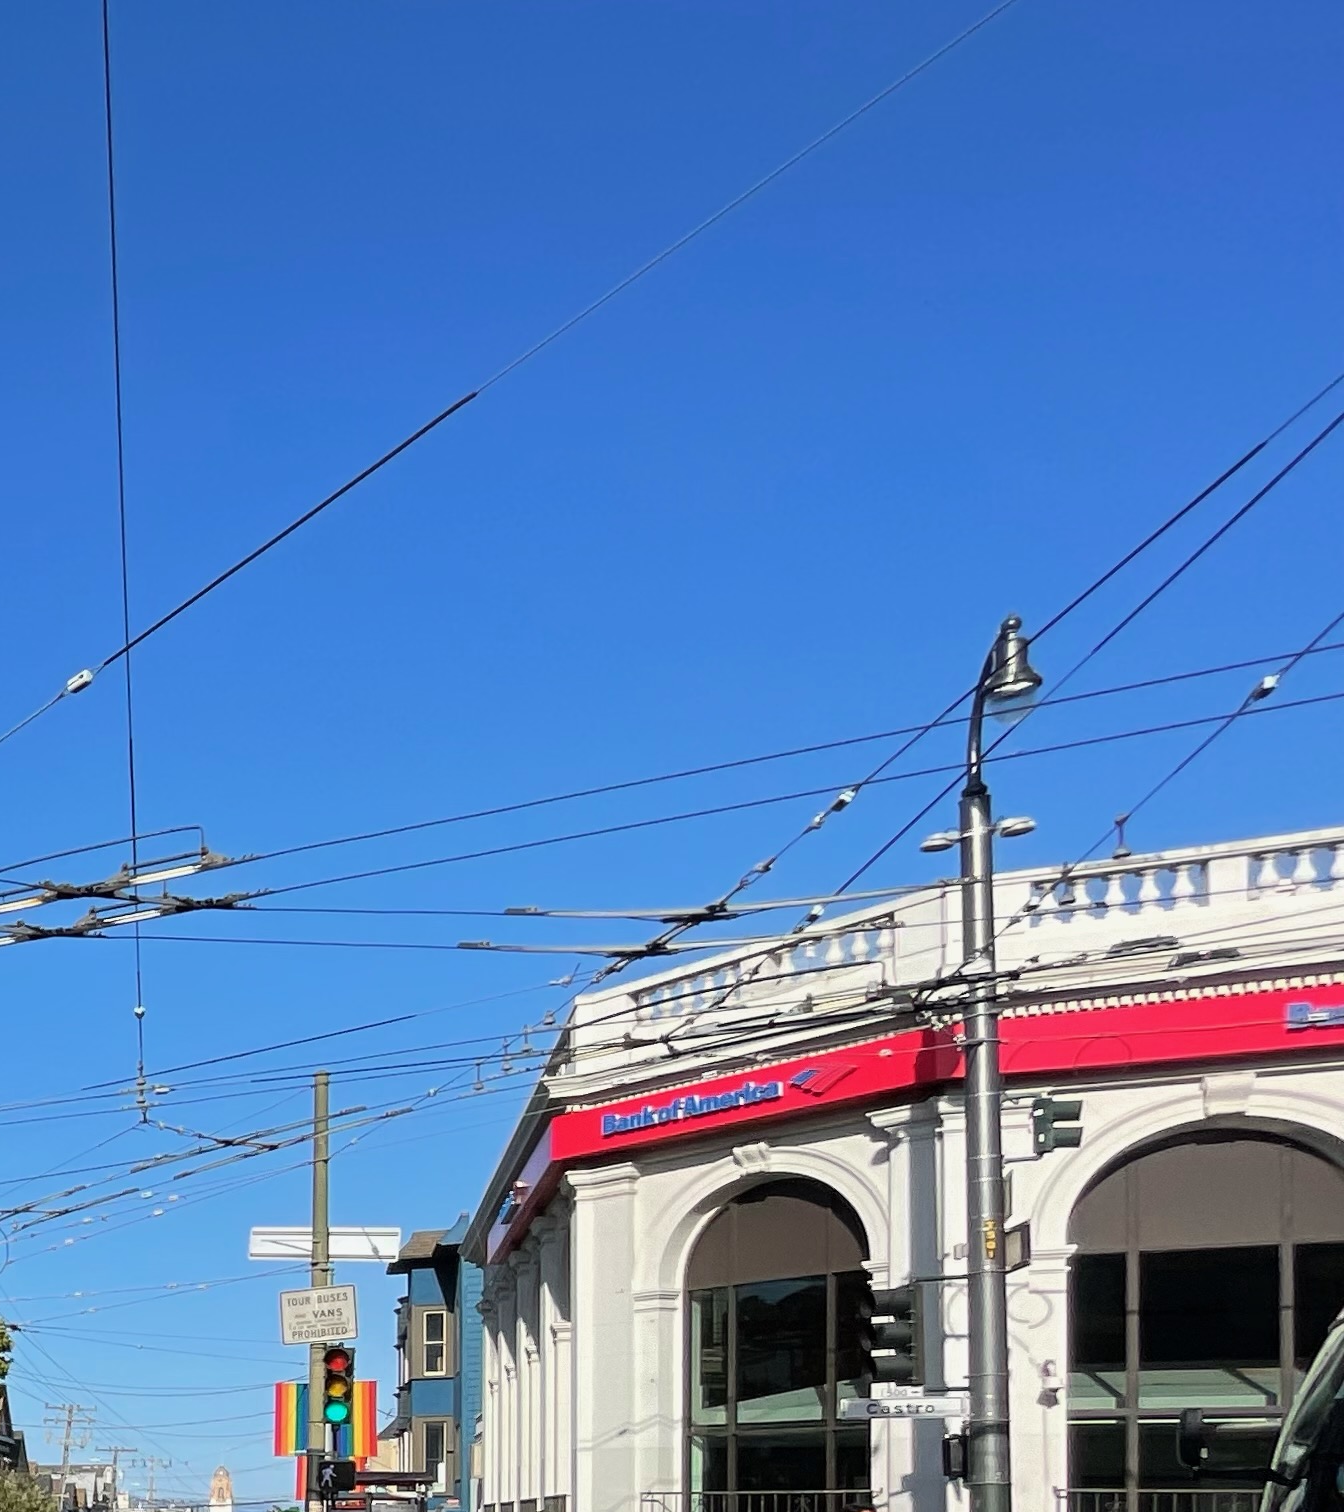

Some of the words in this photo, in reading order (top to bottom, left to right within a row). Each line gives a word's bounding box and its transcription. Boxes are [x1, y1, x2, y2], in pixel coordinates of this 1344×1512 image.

[602, 1106, 658, 1136] Bank
[660, 1098, 683, 1121] of
[683, 1081, 784, 1115] America
[287, 1296, 311, 1307] TOUR
[317, 1292, 348, 1304] BUSES
[313, 1308, 343, 1319] VANS
[292, 1327, 348, 1339] PROHIBITED
[866, 1403, 935, 1415] Castro
